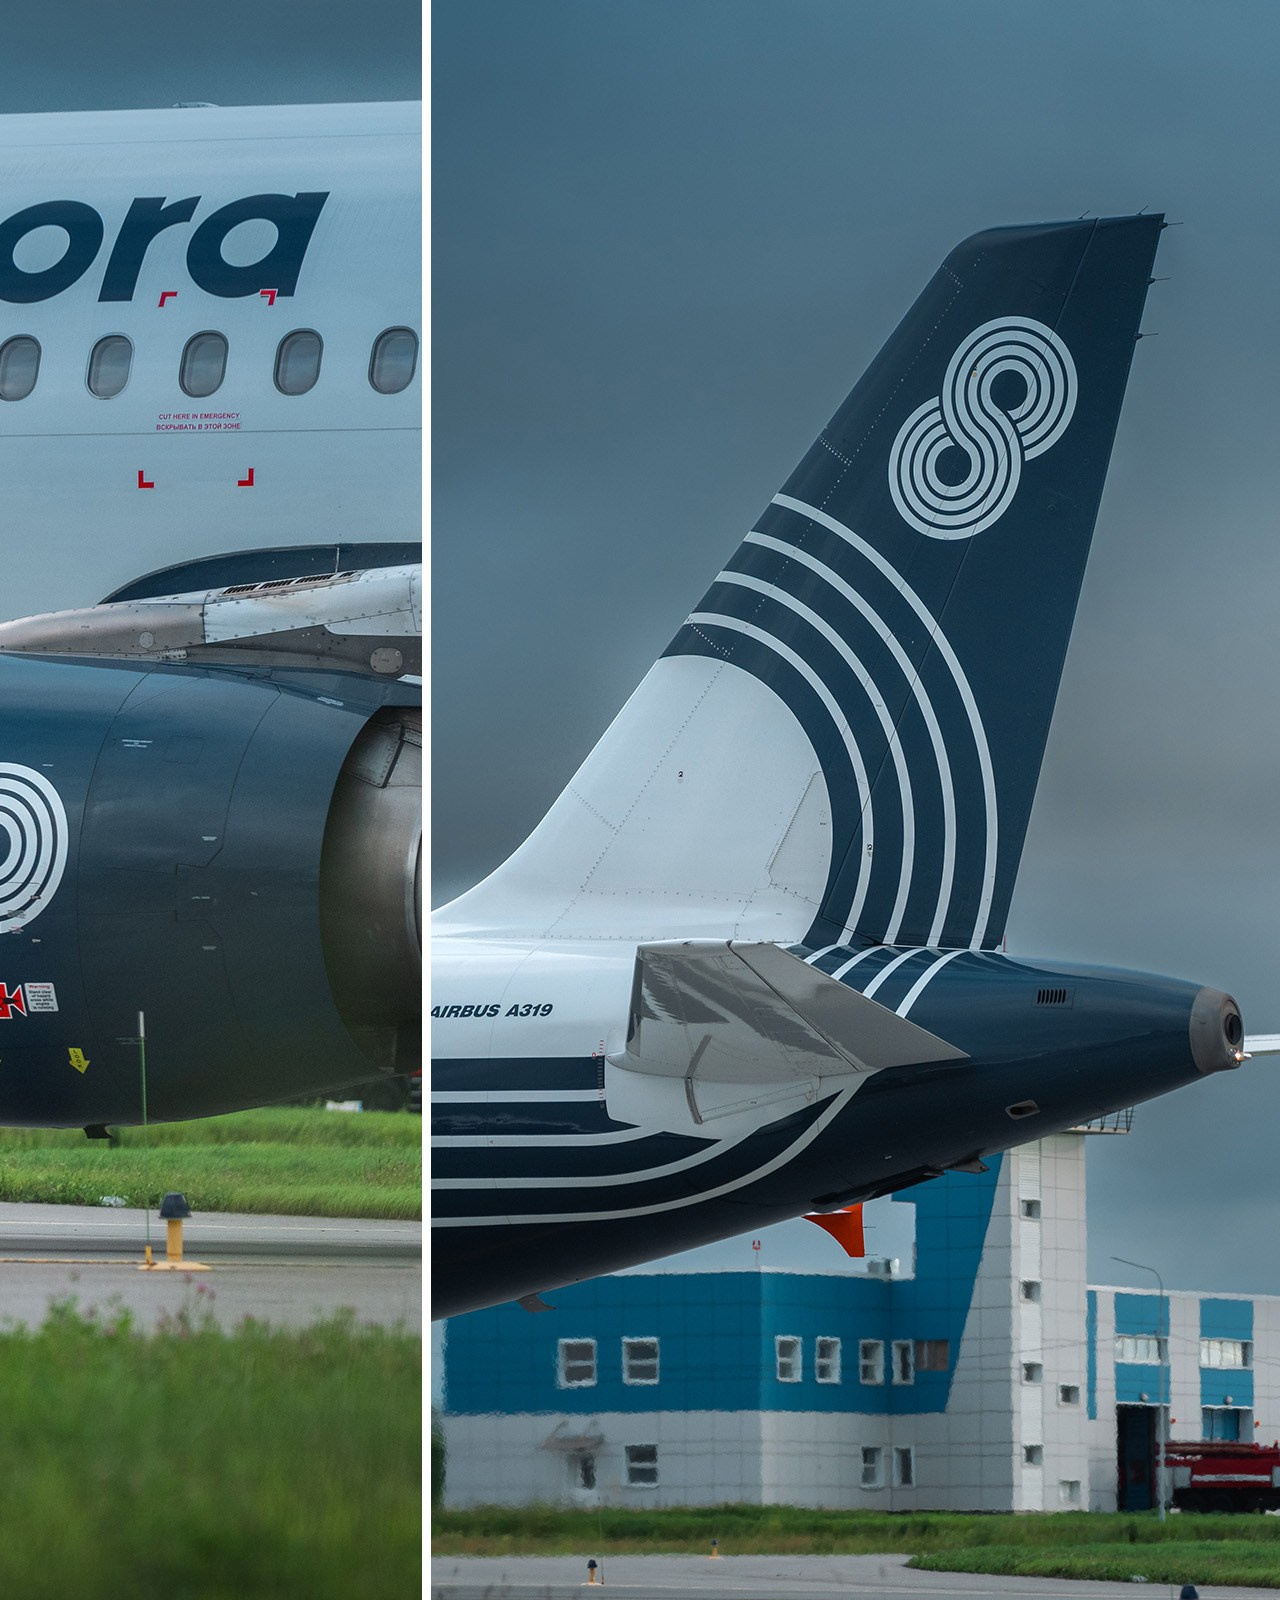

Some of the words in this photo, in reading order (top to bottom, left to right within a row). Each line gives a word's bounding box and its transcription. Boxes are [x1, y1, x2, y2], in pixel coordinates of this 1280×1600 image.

[156, 423, 197, 431] ВСКРЫВАТЬ
[204, 422, 222, 430] ЭТОЙ
[431, 1004, 501, 1018] AIRBUS
[505, 1003, 553, 1017] A319
[73, 1049, 83, 1068] LOOK
